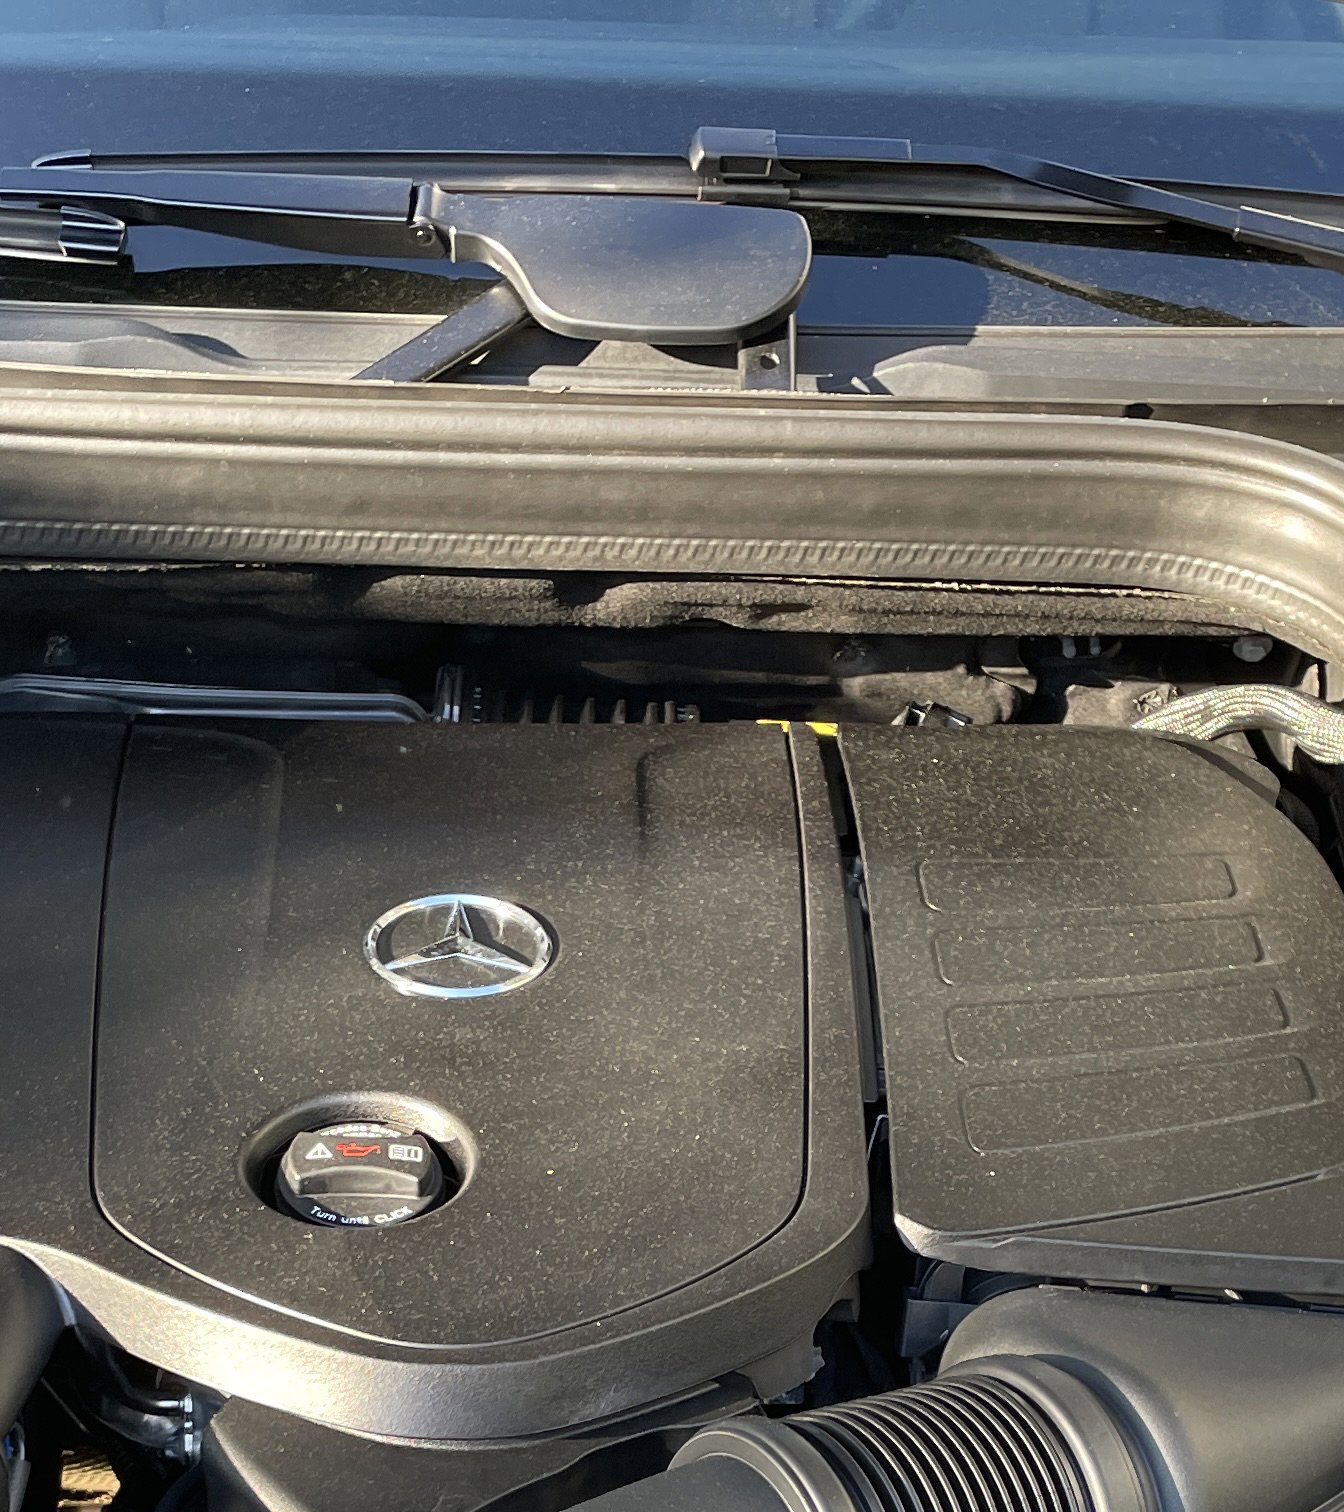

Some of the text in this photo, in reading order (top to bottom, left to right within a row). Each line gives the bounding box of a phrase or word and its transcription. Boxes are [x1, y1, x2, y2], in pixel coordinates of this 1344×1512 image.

[311, 1205, 413, 1225] Turn until CLICK
